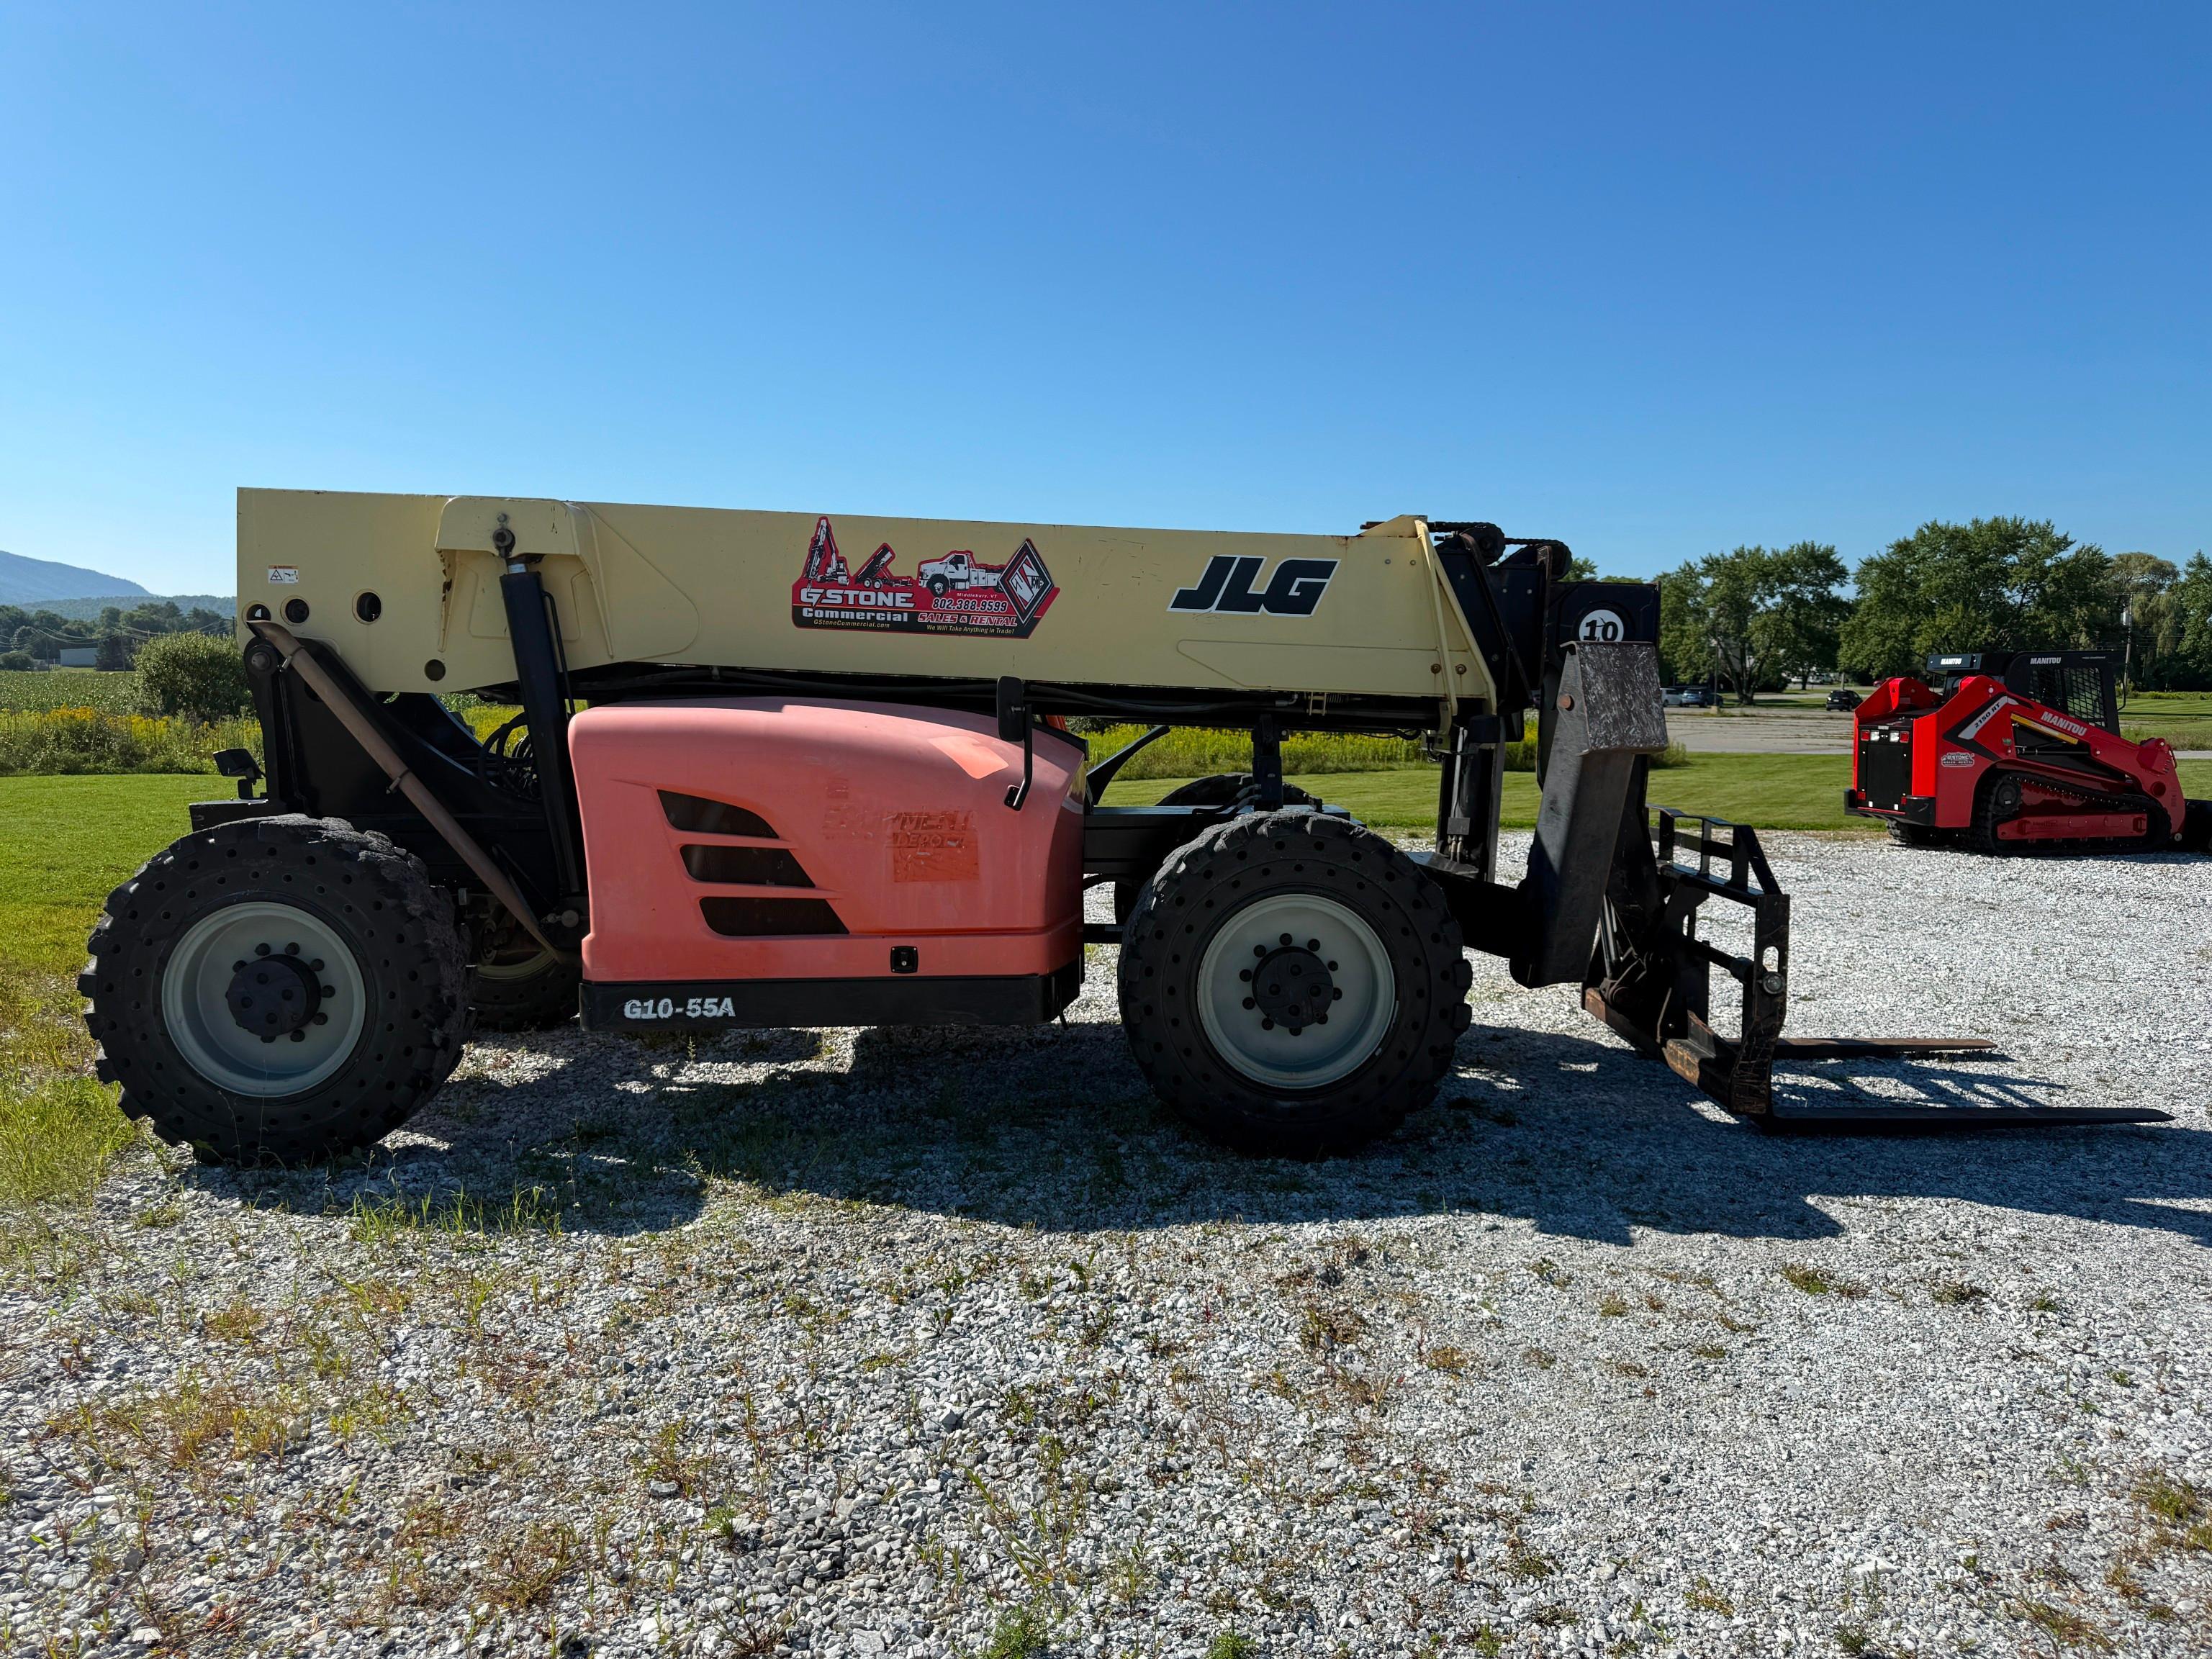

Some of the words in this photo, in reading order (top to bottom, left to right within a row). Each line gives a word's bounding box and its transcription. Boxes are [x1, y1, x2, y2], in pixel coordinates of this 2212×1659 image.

[1166, 554, 1342, 617] JLG
[932, 597, 1008, 612] 802.388.9599
[803, 607, 908, 622] Commercial
[918, 612, 958, 623] SALES
[969, 615, 1018, 626] RENTAL
[814, 619, 890, 628] GStoneCommercial.com
[1584, 620, 1619, 641] 10
[1974, 711, 1991, 728] 2150
[2041, 711, 2087, 736] MANITOU
[624, 998, 736, 1019] G10-55A
